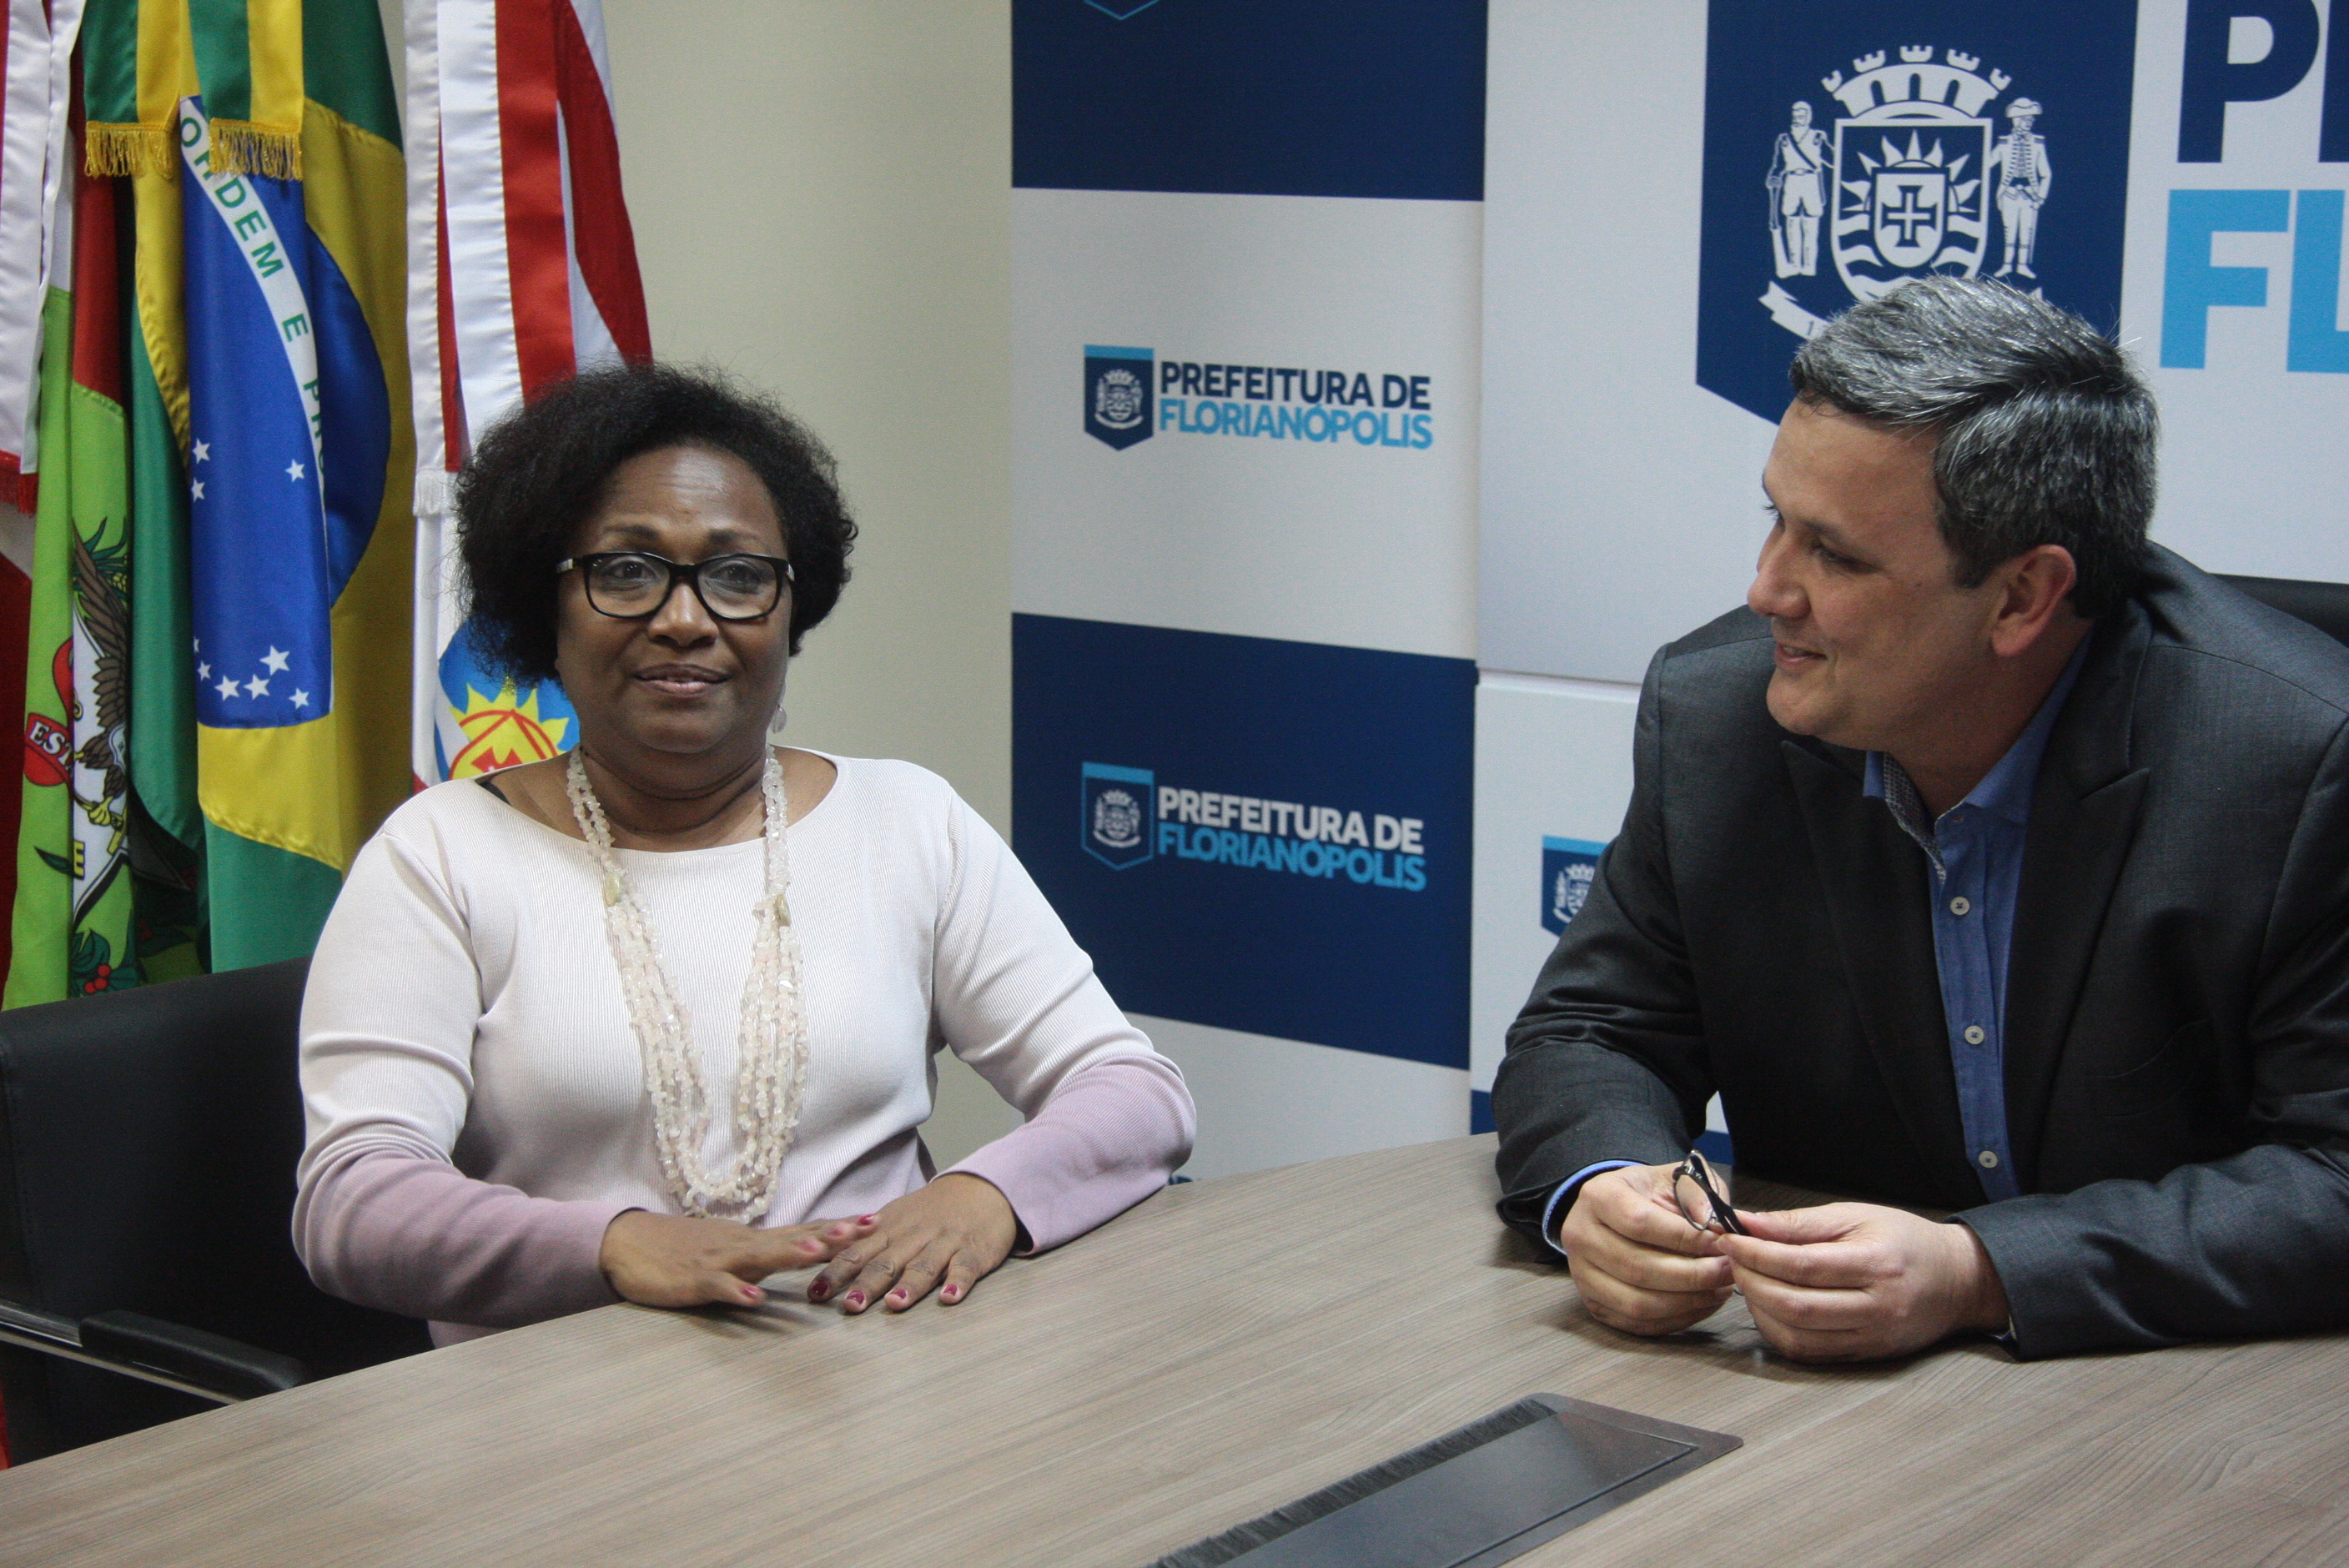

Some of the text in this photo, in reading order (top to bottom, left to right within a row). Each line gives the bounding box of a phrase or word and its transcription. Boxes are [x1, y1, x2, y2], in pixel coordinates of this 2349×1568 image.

[2177, 0, 2349, 163] P
[282, 313, 309, 343] E
[1160, 361, 1431, 410] PREFEITURA DE
[1159, 398, 1433, 450] FLORIANÓPOLIS
[1158, 786, 1424, 855] PREFEITURA DE
[1158, 822, 1427, 892] FLORIANÓPOLIS
